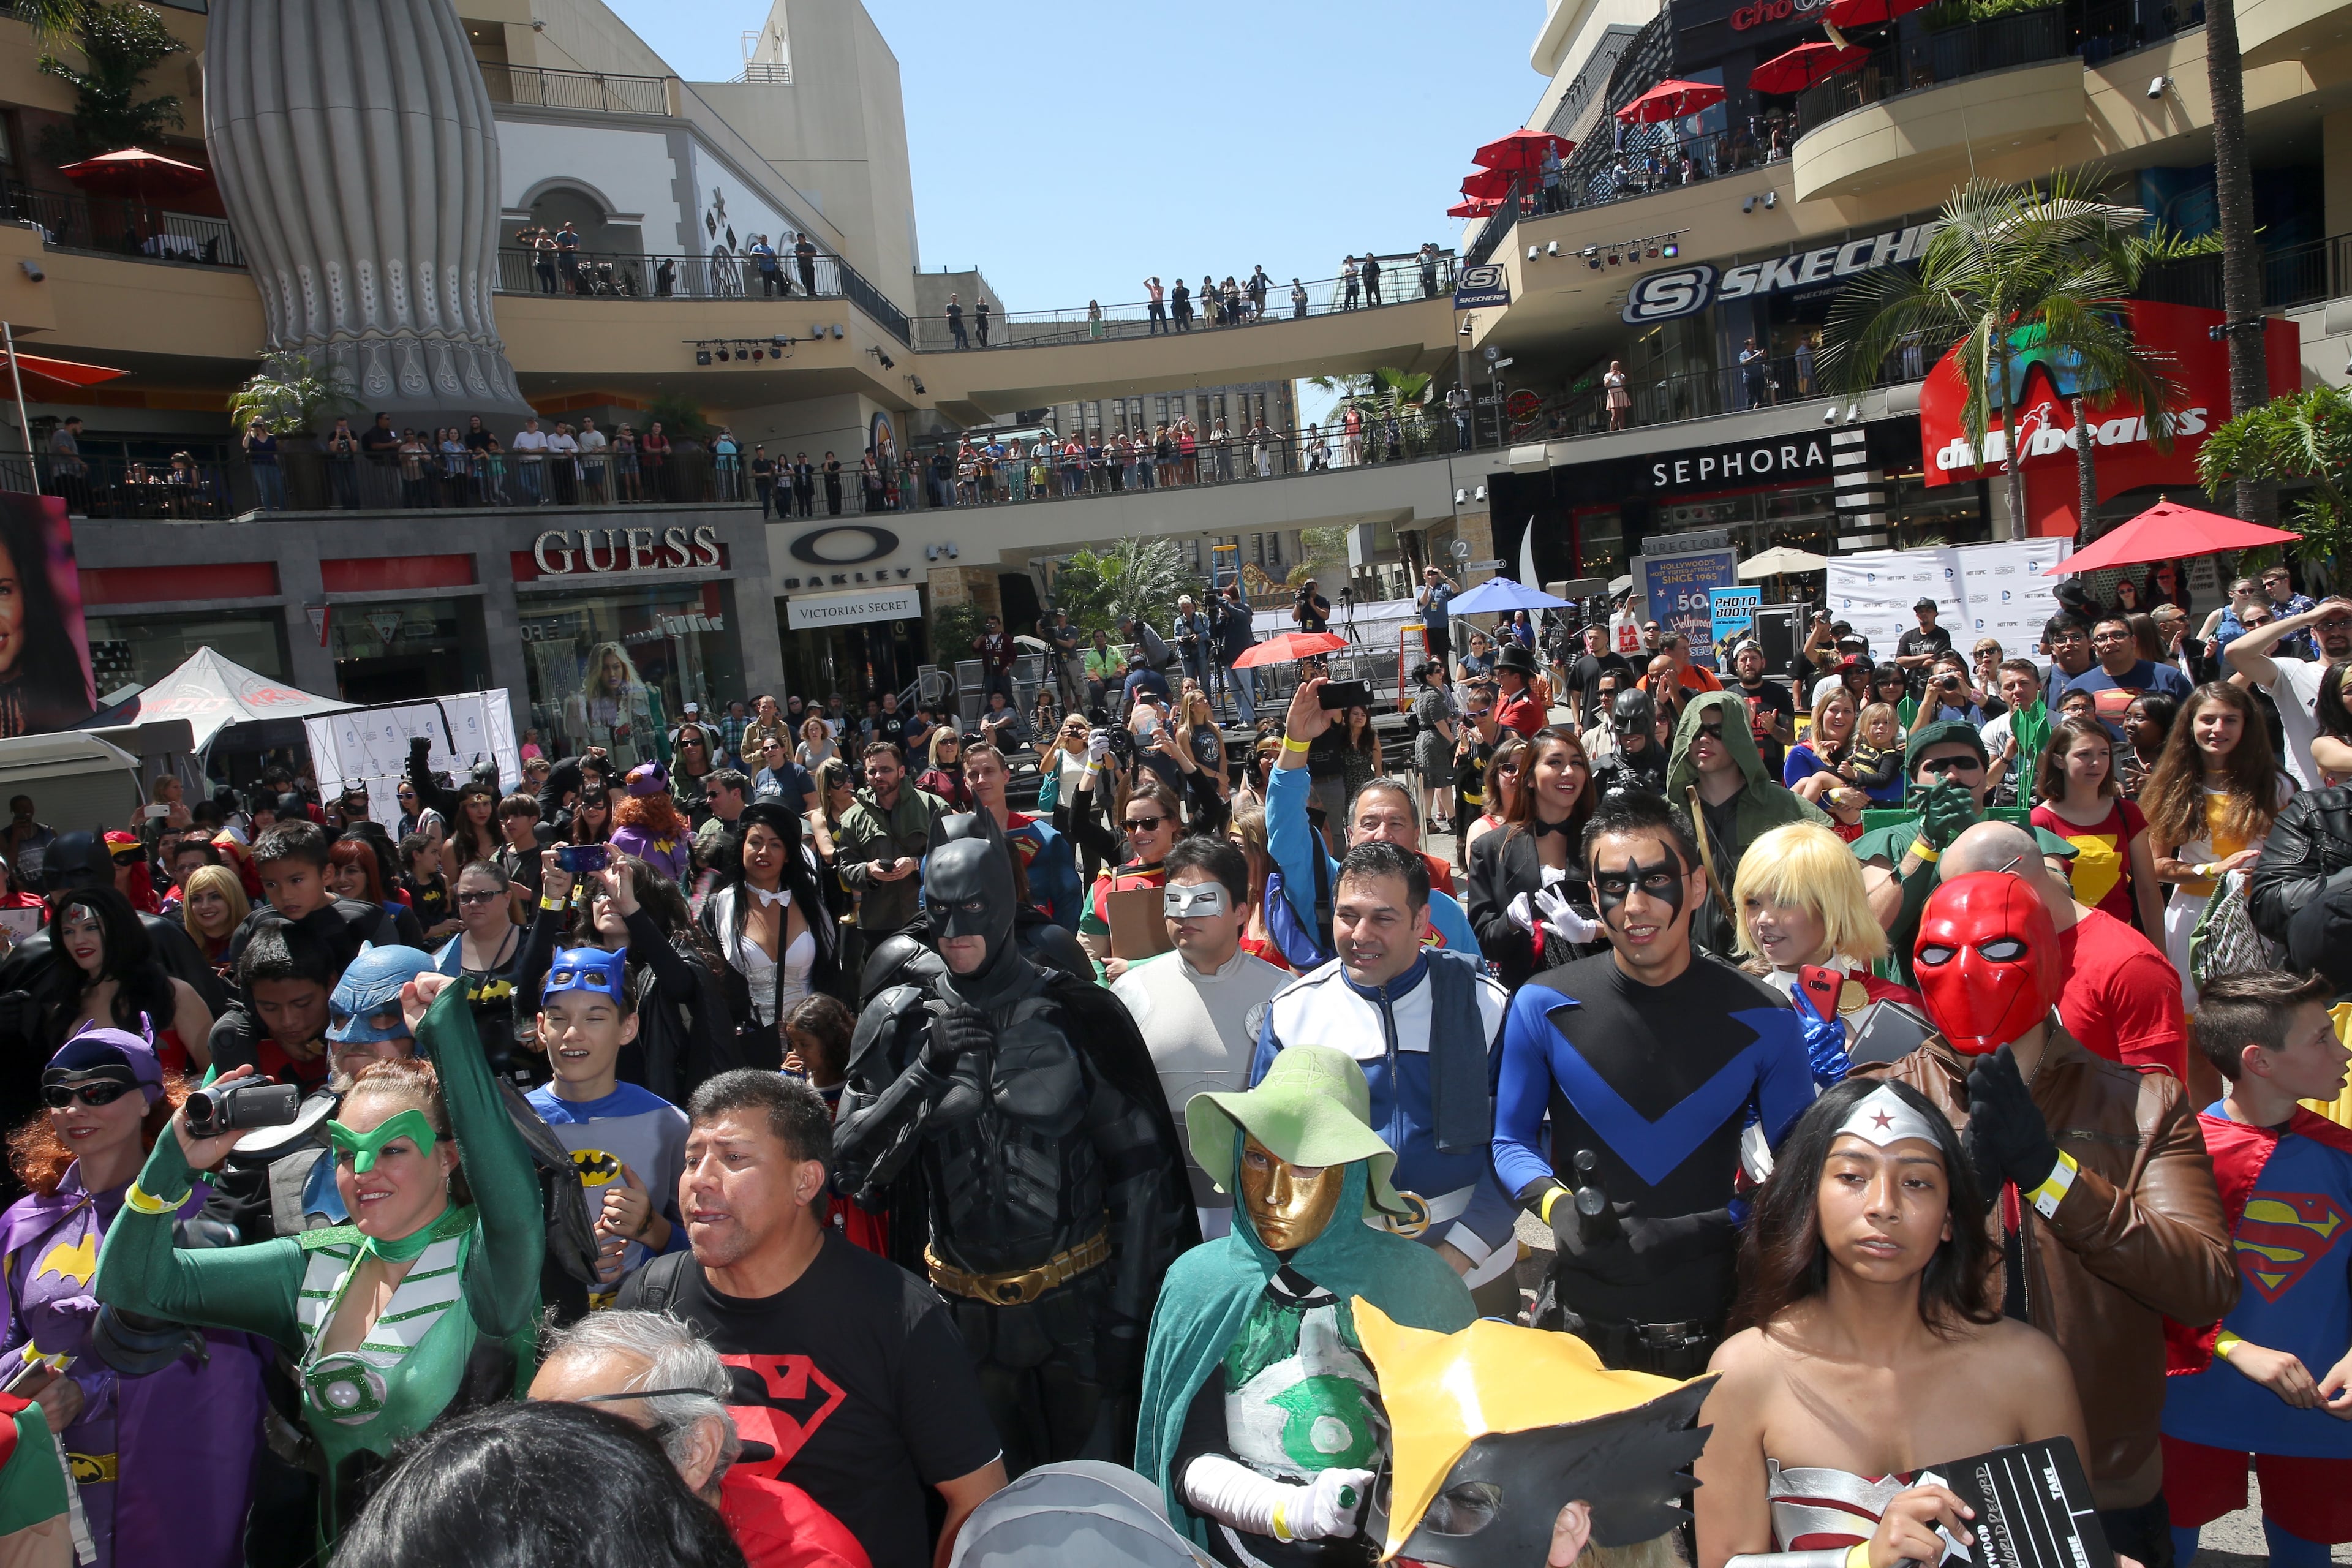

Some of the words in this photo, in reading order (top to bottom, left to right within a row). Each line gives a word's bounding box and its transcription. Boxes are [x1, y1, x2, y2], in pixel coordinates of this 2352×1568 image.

[1458, 294, 1506, 304] SKECHERS
[1488, 348, 1496, 359] 3
[1653, 442, 1825, 486] SEPHORA
[535, 524, 720, 575] GUESS
[1457, 542, 1468, 557] 2
[1640, 535, 1730, 554] DIRECTORY
[1660, 559, 1715, 570] HOLLYWOOD'S
[785, 568, 911, 589] OAKLEY
[1662, 574, 1693, 584] SINCE
[1696, 573, 1717, 581] 1965
[800, 604, 864, 619] VICTORIA'S
[869, 600, 908, 612] SECRET
[1678, 594, 1707, 611] 50
[1715, 597, 1757, 608] PHOTO
[1716, 608, 1752, 618] BOOT
[1619, 625, 1637, 636] LA
[1670, 614, 1713, 635] Hollywood
[1619, 636, 1639, 647] LA
[2043, 1466, 2062, 1501] TAKE
[2066, 1535, 2087, 1568] CENE
